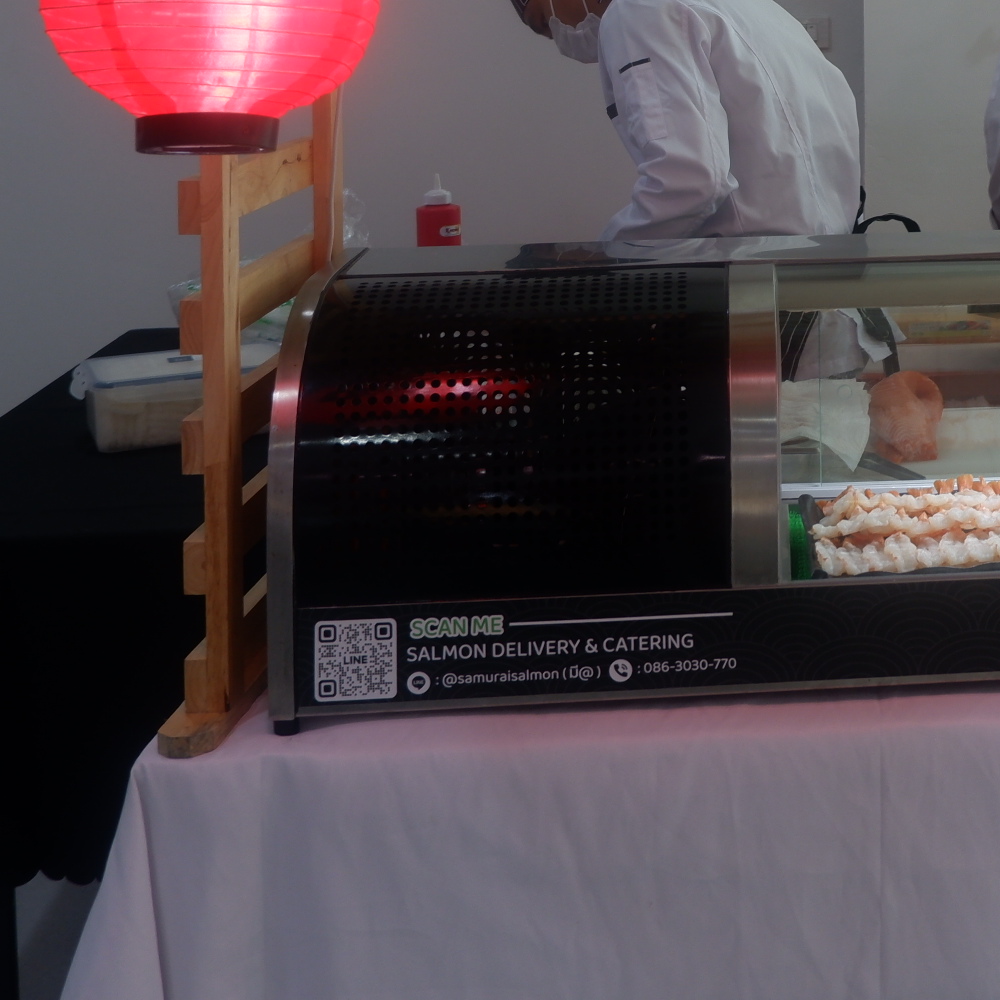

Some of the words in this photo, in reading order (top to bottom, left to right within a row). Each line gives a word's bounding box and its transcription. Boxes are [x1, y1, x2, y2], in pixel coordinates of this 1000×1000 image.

[410, 617, 468, 639] SCAN
[470, 615, 504, 636] ME
[406, 643, 486, 662] SALMON
[492, 639, 580, 658] DELIVERY
[585, 638, 598, 653] &
[602, 633, 694, 652] CATERING
[343, 655, 368, 665] LINE
[643, 657, 737, 673] 086-3030-770
